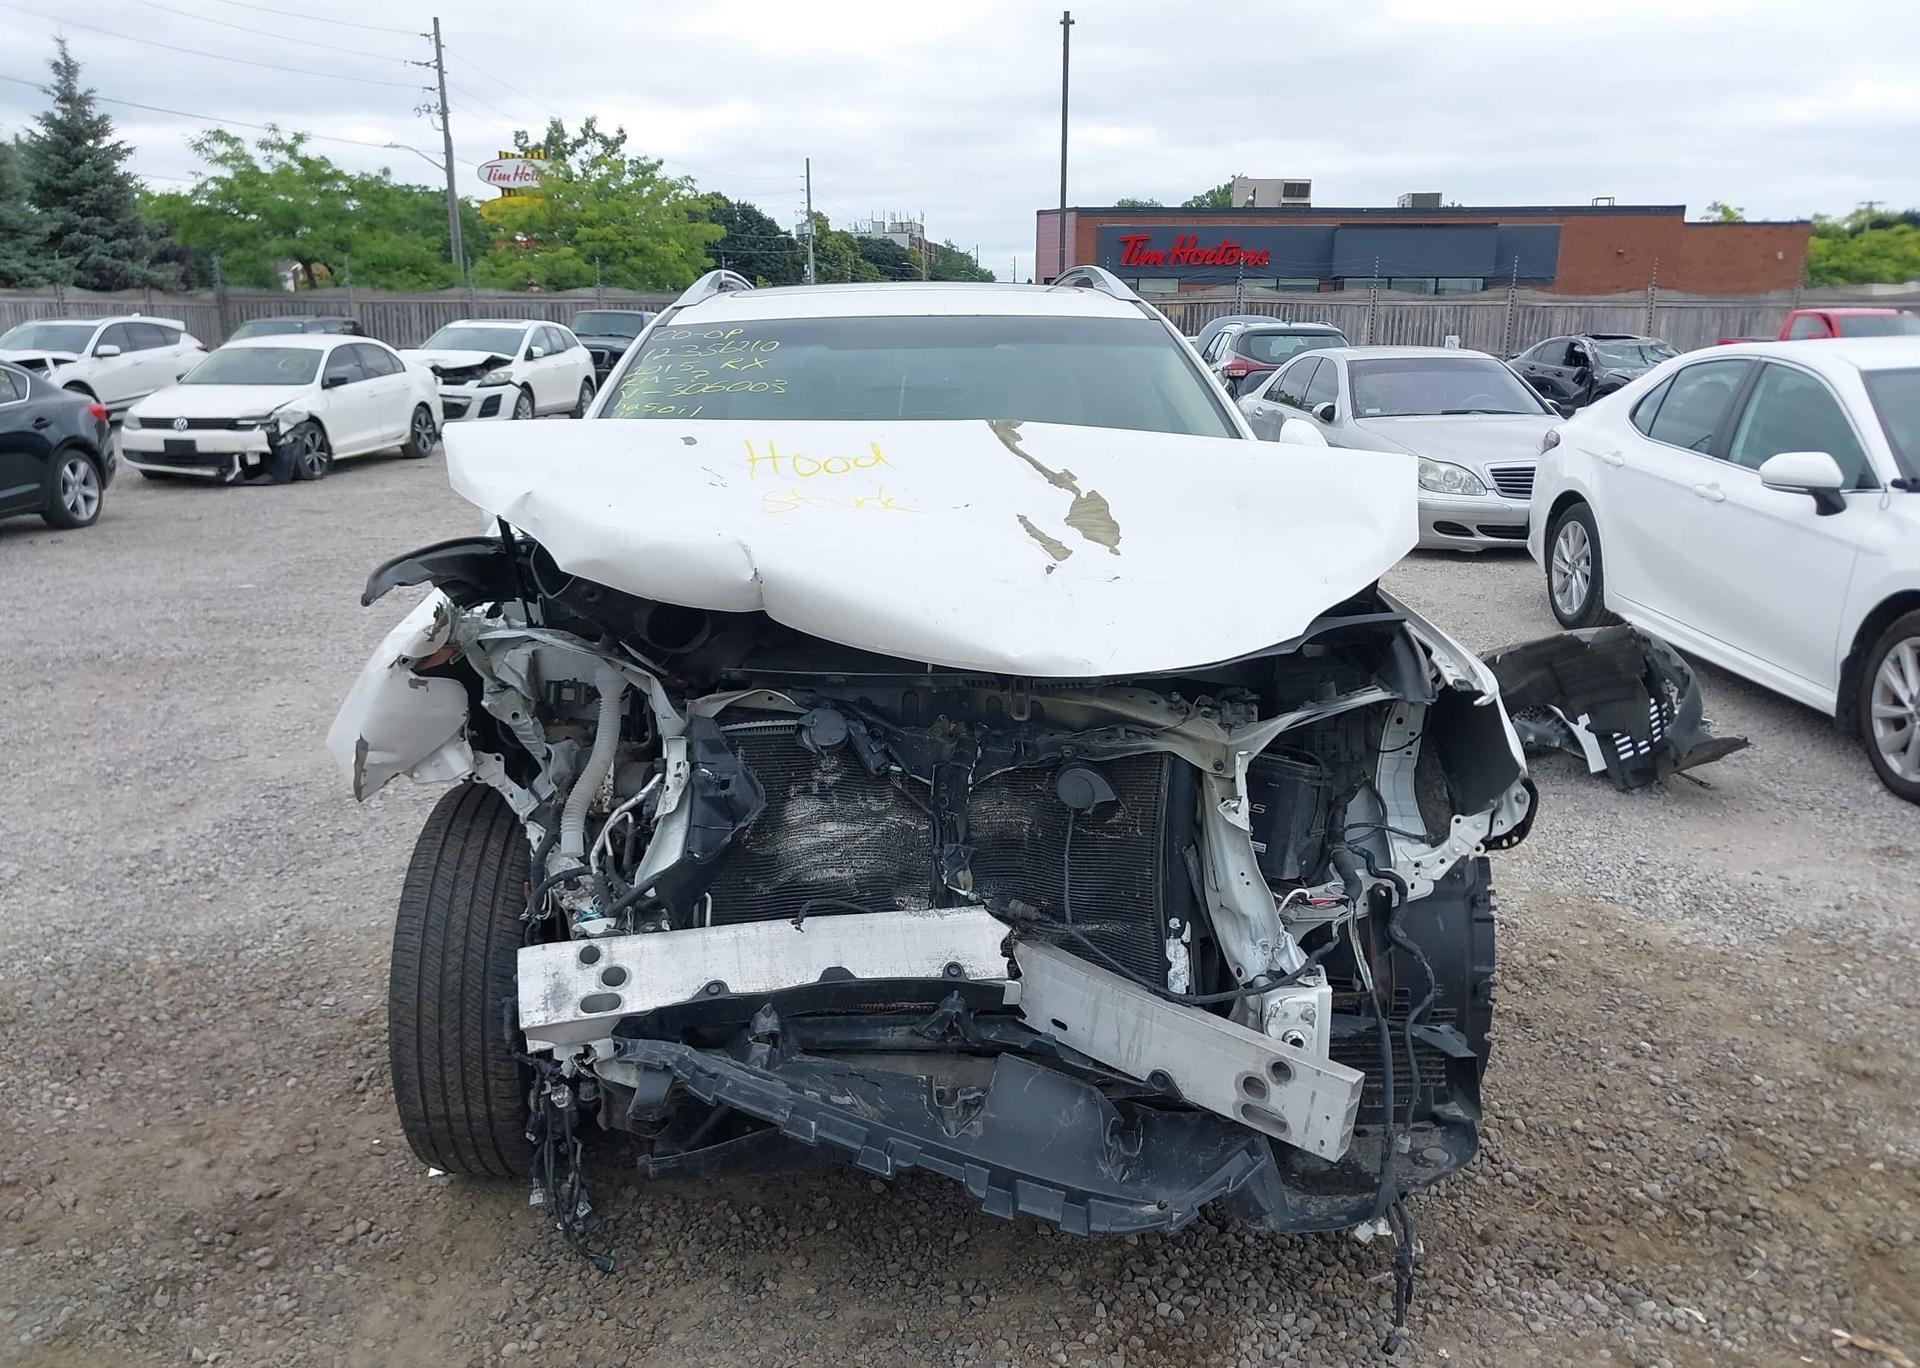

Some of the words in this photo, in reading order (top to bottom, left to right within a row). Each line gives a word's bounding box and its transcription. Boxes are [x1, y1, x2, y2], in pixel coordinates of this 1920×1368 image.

[485, 164, 511, 181] Tim
[1118, 233, 1163, 266] Tim
[1168, 233, 1269, 266] Hortons
[720, 356, 774, 372] RX
[745, 439, 896, 480] Hood
